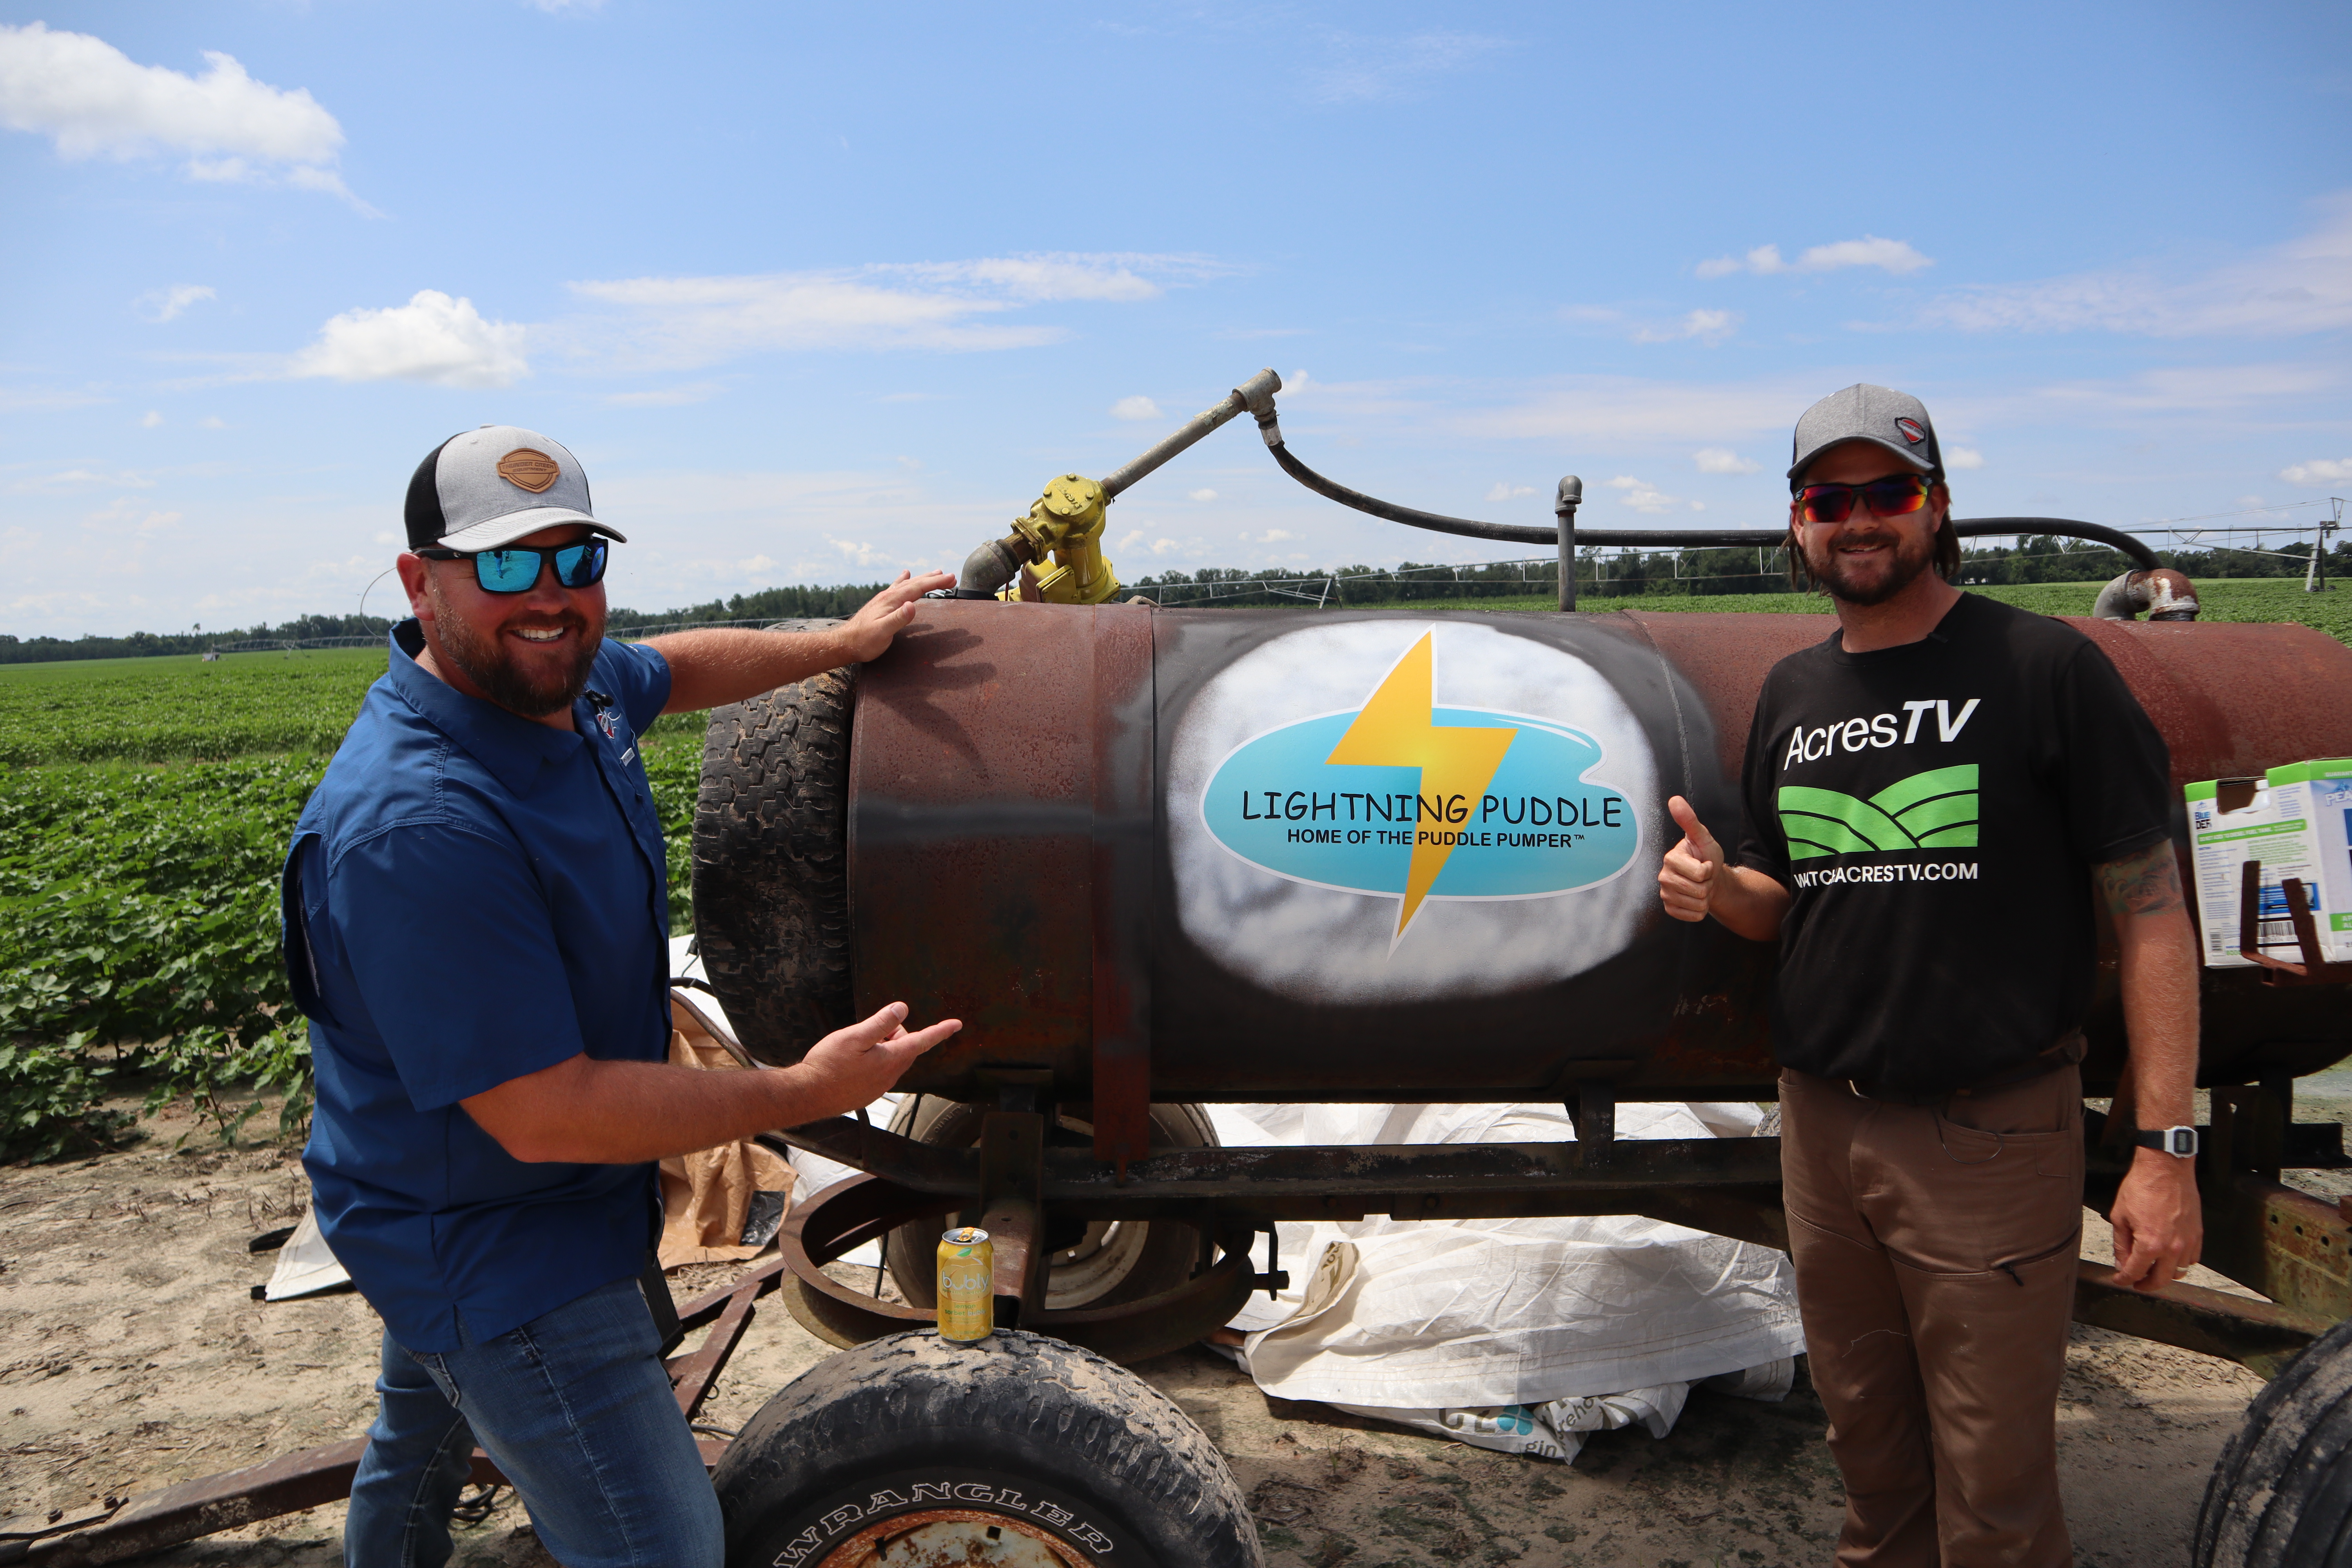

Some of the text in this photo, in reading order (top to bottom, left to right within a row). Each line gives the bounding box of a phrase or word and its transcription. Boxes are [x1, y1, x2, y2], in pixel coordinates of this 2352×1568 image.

[1784, 699, 1981, 770] AcresTV
[1243, 791, 1622, 827] LIGHTNING PUDDLE
[2324, 790, 2352, 806] PEA
[1288, 829, 1342, 843] HOME
[1348, 830, 1372, 844] OF
[1376, 831, 1413, 845] THE
[1419, 832, 1491, 846] PUDDLE
[934, 1104, 962, 1132] QUALITY
[942, 1270, 989, 1292] bubly
[773, 1482, 1113, 1568] WRANGLER
